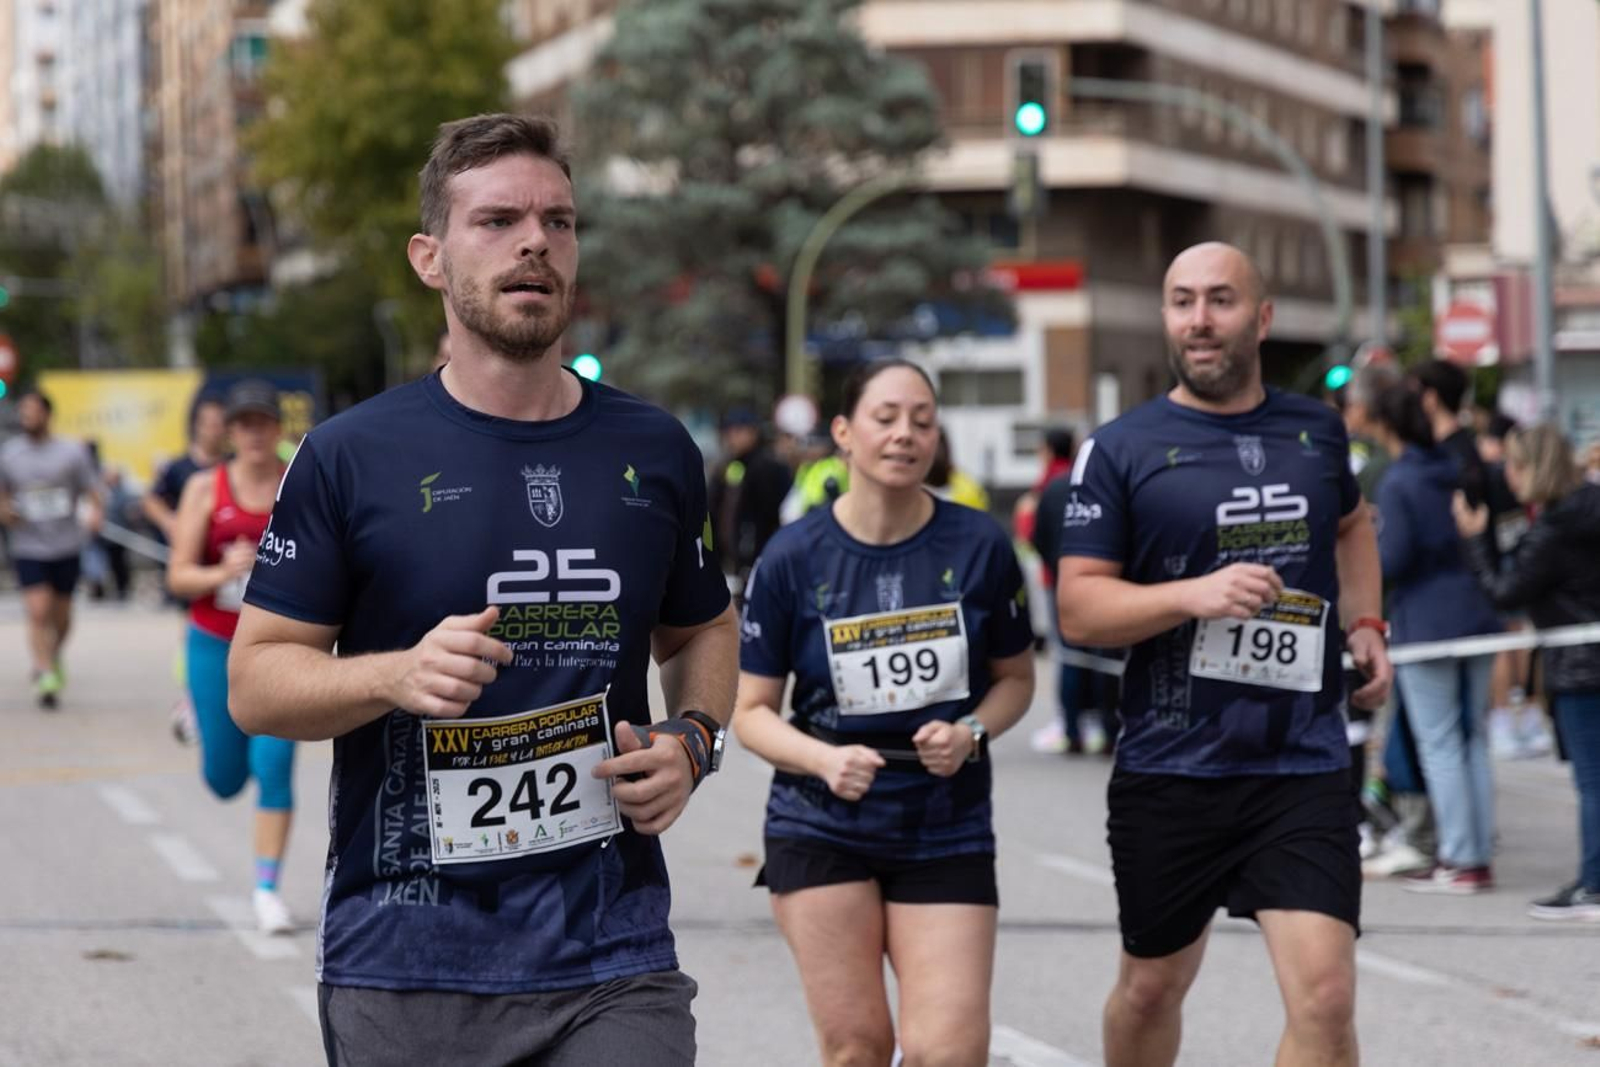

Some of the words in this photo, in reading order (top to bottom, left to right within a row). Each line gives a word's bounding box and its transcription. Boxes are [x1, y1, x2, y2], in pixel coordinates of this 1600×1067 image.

[1216, 483, 1309, 526] 25
[487, 548, 621, 604] 25
[486, 621, 621, 639] POPULAR
[494, 603, 619, 620] ARRERA
[543, 639, 620, 652] caminata
[1226, 624, 1297, 665] 198
[862, 648, 939, 688] 199
[432, 728, 470, 753] XXV
[472, 720, 537, 739] CARRERA
[539, 704, 597, 728] POPULAR
[473, 740, 482, 753] y
[492, 734, 529, 751] gran
[537, 715, 599, 740] caminata
[472, 755, 487, 766] LA
[519, 748, 534, 760] LA
[467, 763, 580, 828] 242
[382, 802, 406, 876] SANTA
